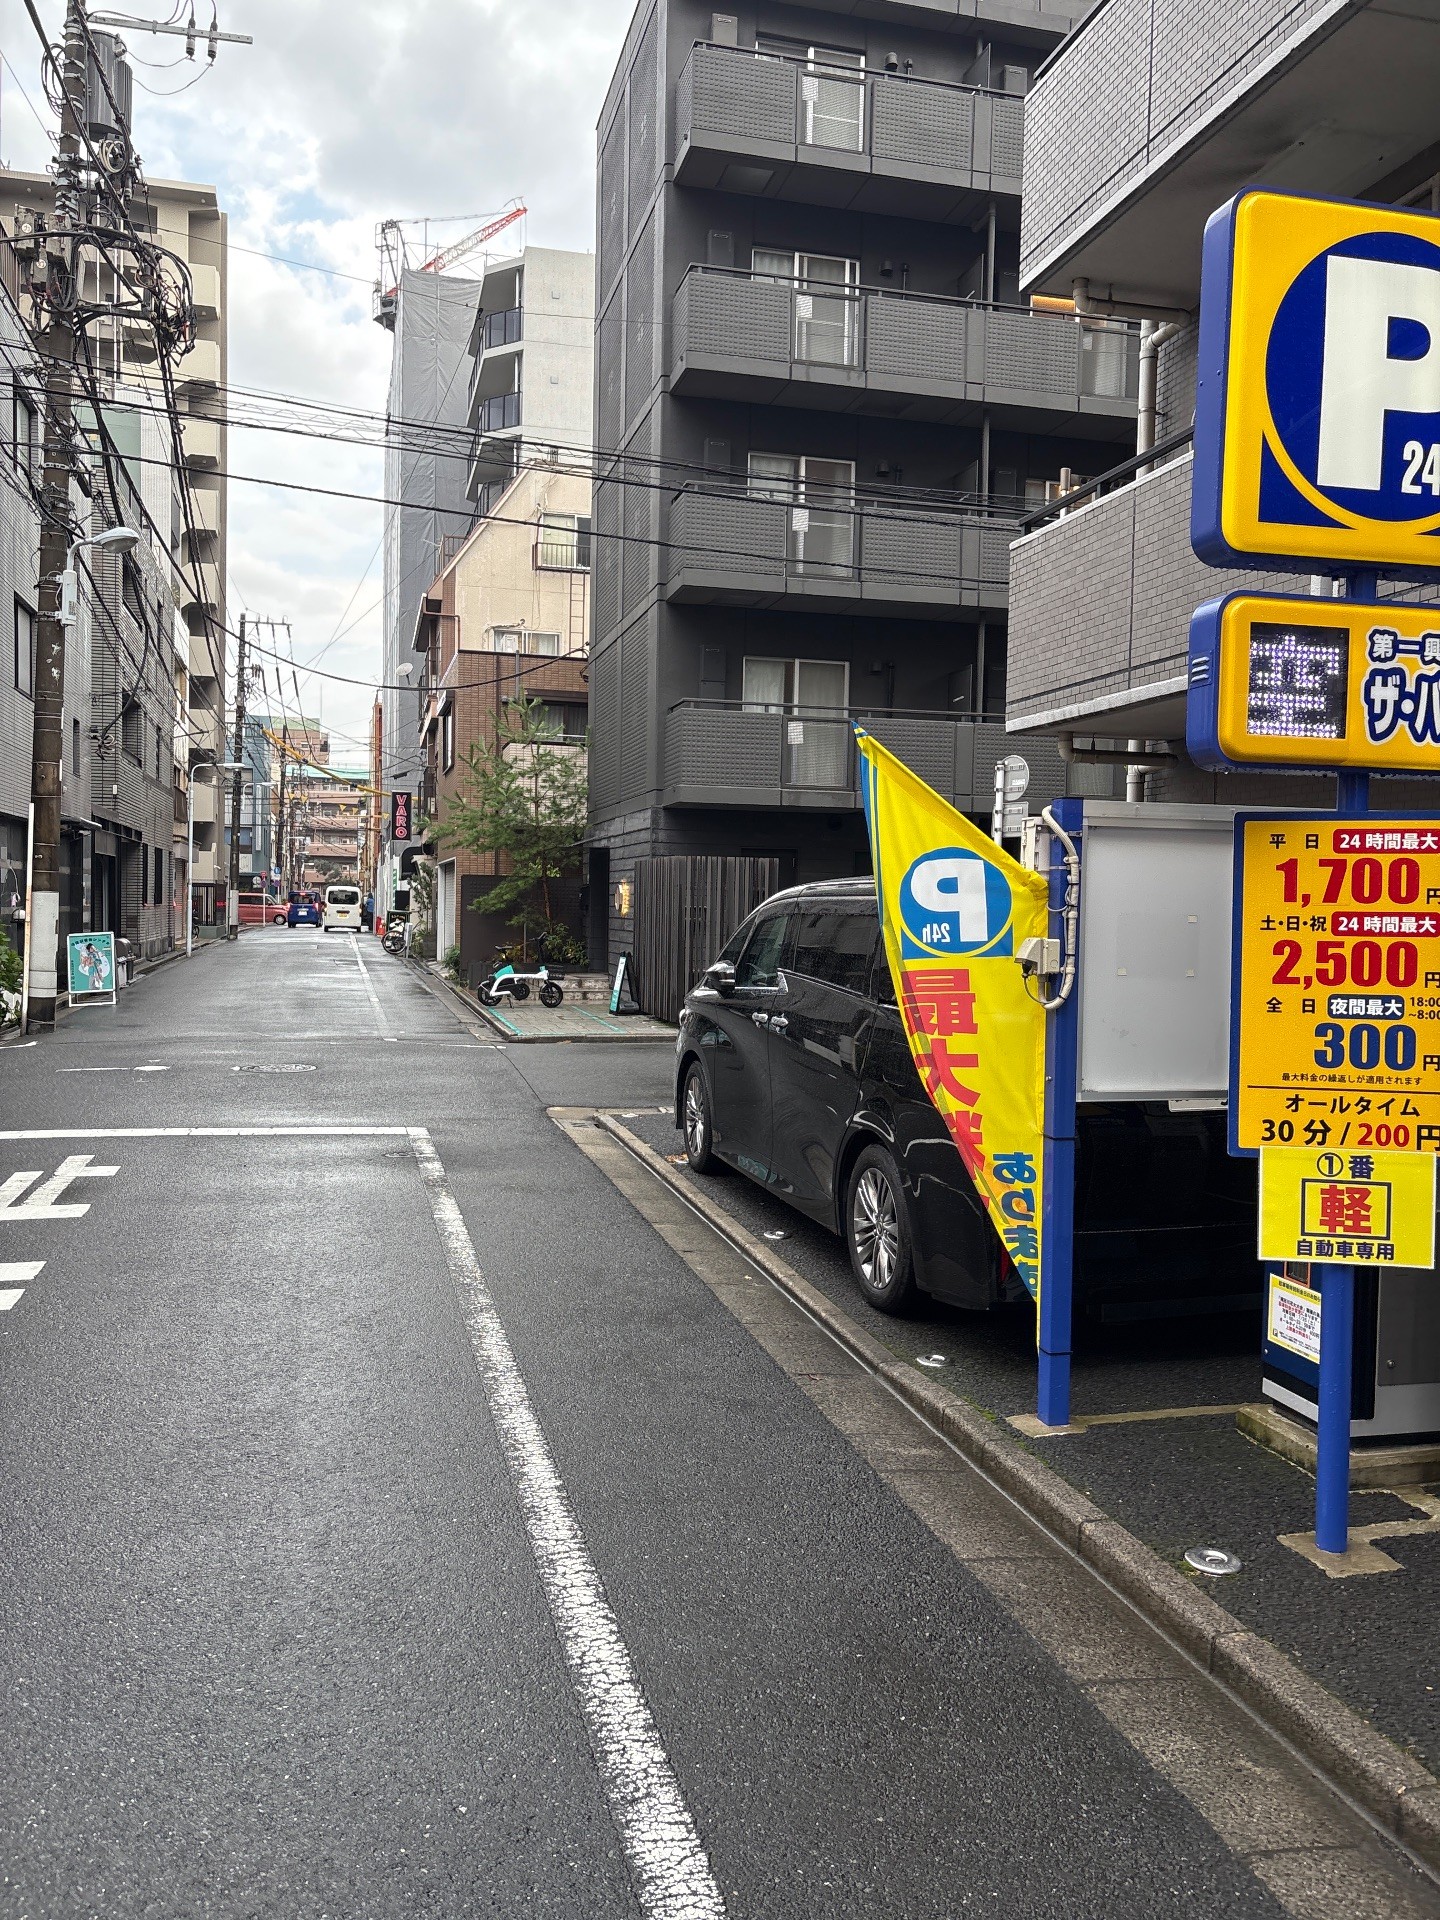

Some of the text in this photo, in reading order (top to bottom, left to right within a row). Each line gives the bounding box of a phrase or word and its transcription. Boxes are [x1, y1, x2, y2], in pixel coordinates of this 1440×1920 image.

[1317, 254, 1440, 491] P
[396, 795, 407, 838] VARO
[1330, 998, 1403, 1016] 夜間最大
[1282, 1072, 1423, 1085] 最大料金の繰返しが適用されます
[1286, 1094, 1421, 1117] オールタイム
[1319, 1184, 1373, 1235] 軽
[1296, 1238, 1395, 1261] 自動車専用
